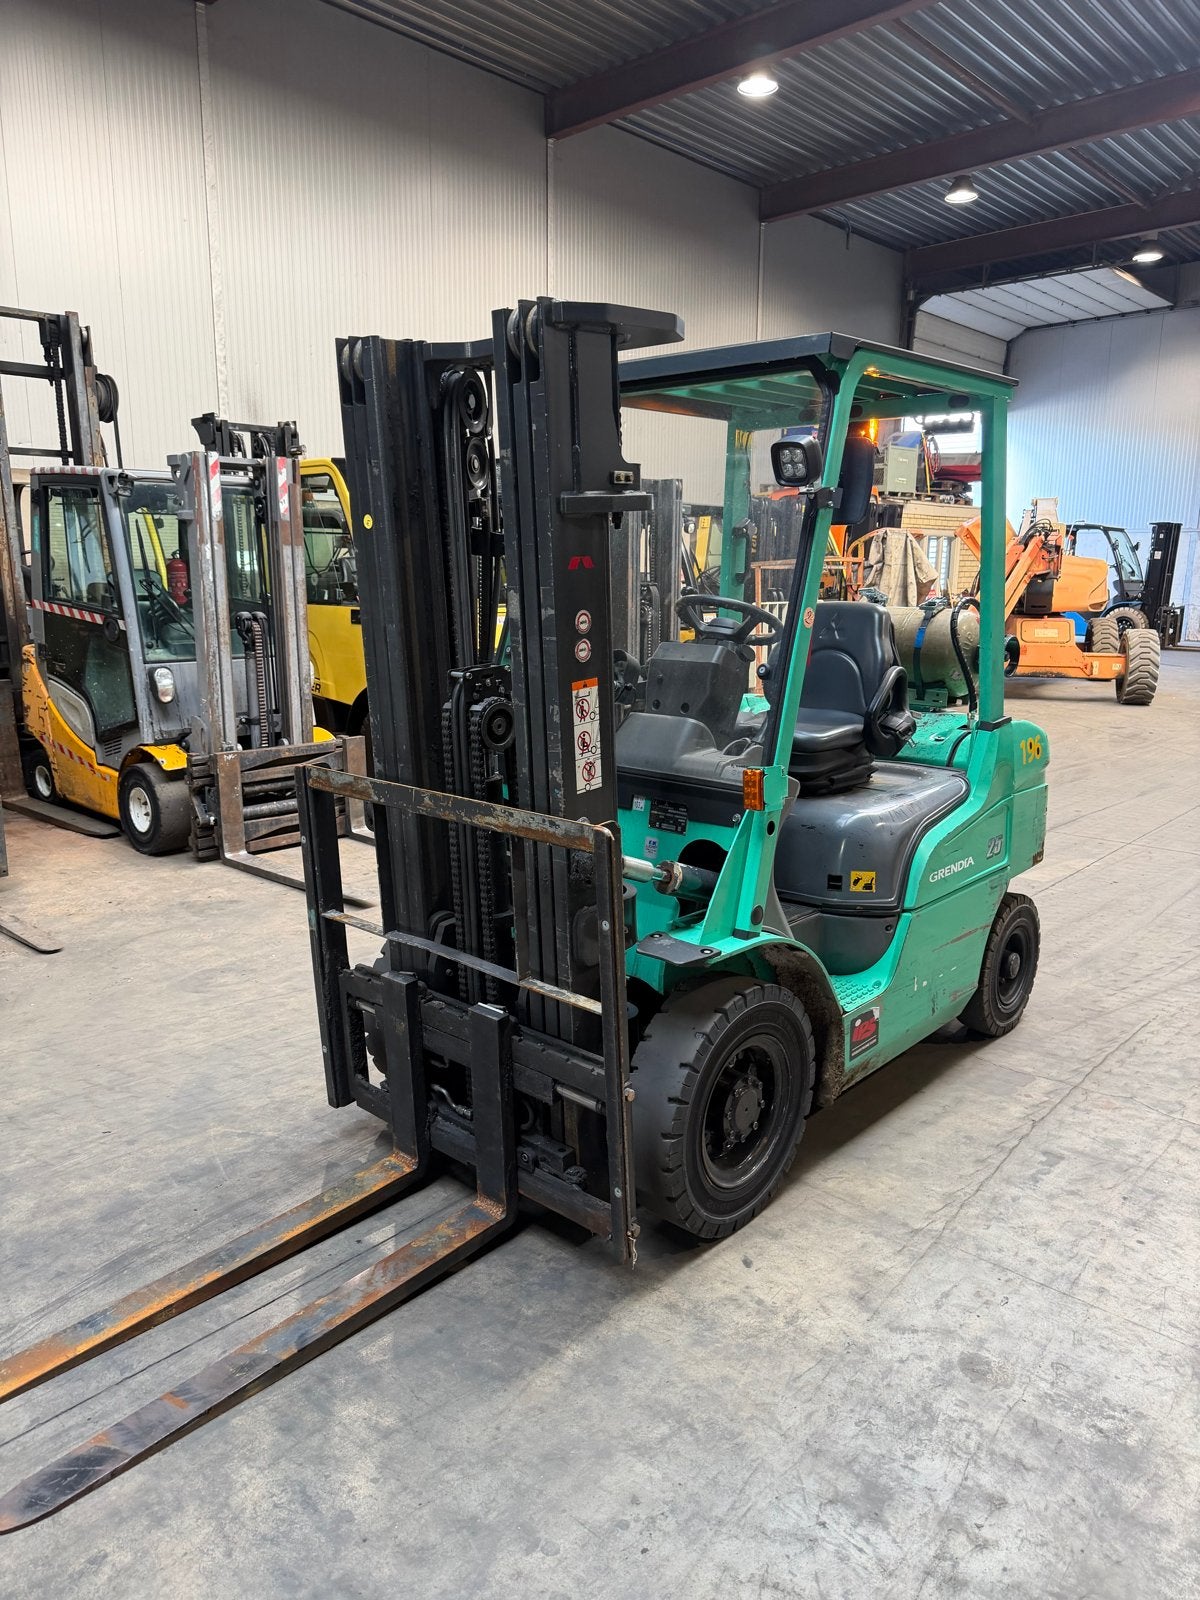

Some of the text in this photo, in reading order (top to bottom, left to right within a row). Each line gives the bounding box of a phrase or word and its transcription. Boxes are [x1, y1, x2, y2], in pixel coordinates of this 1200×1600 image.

[1019, 734, 1042, 766] 196
[986, 834, 1004, 860] 25
[928, 856, 975, 883] GRENDIA
